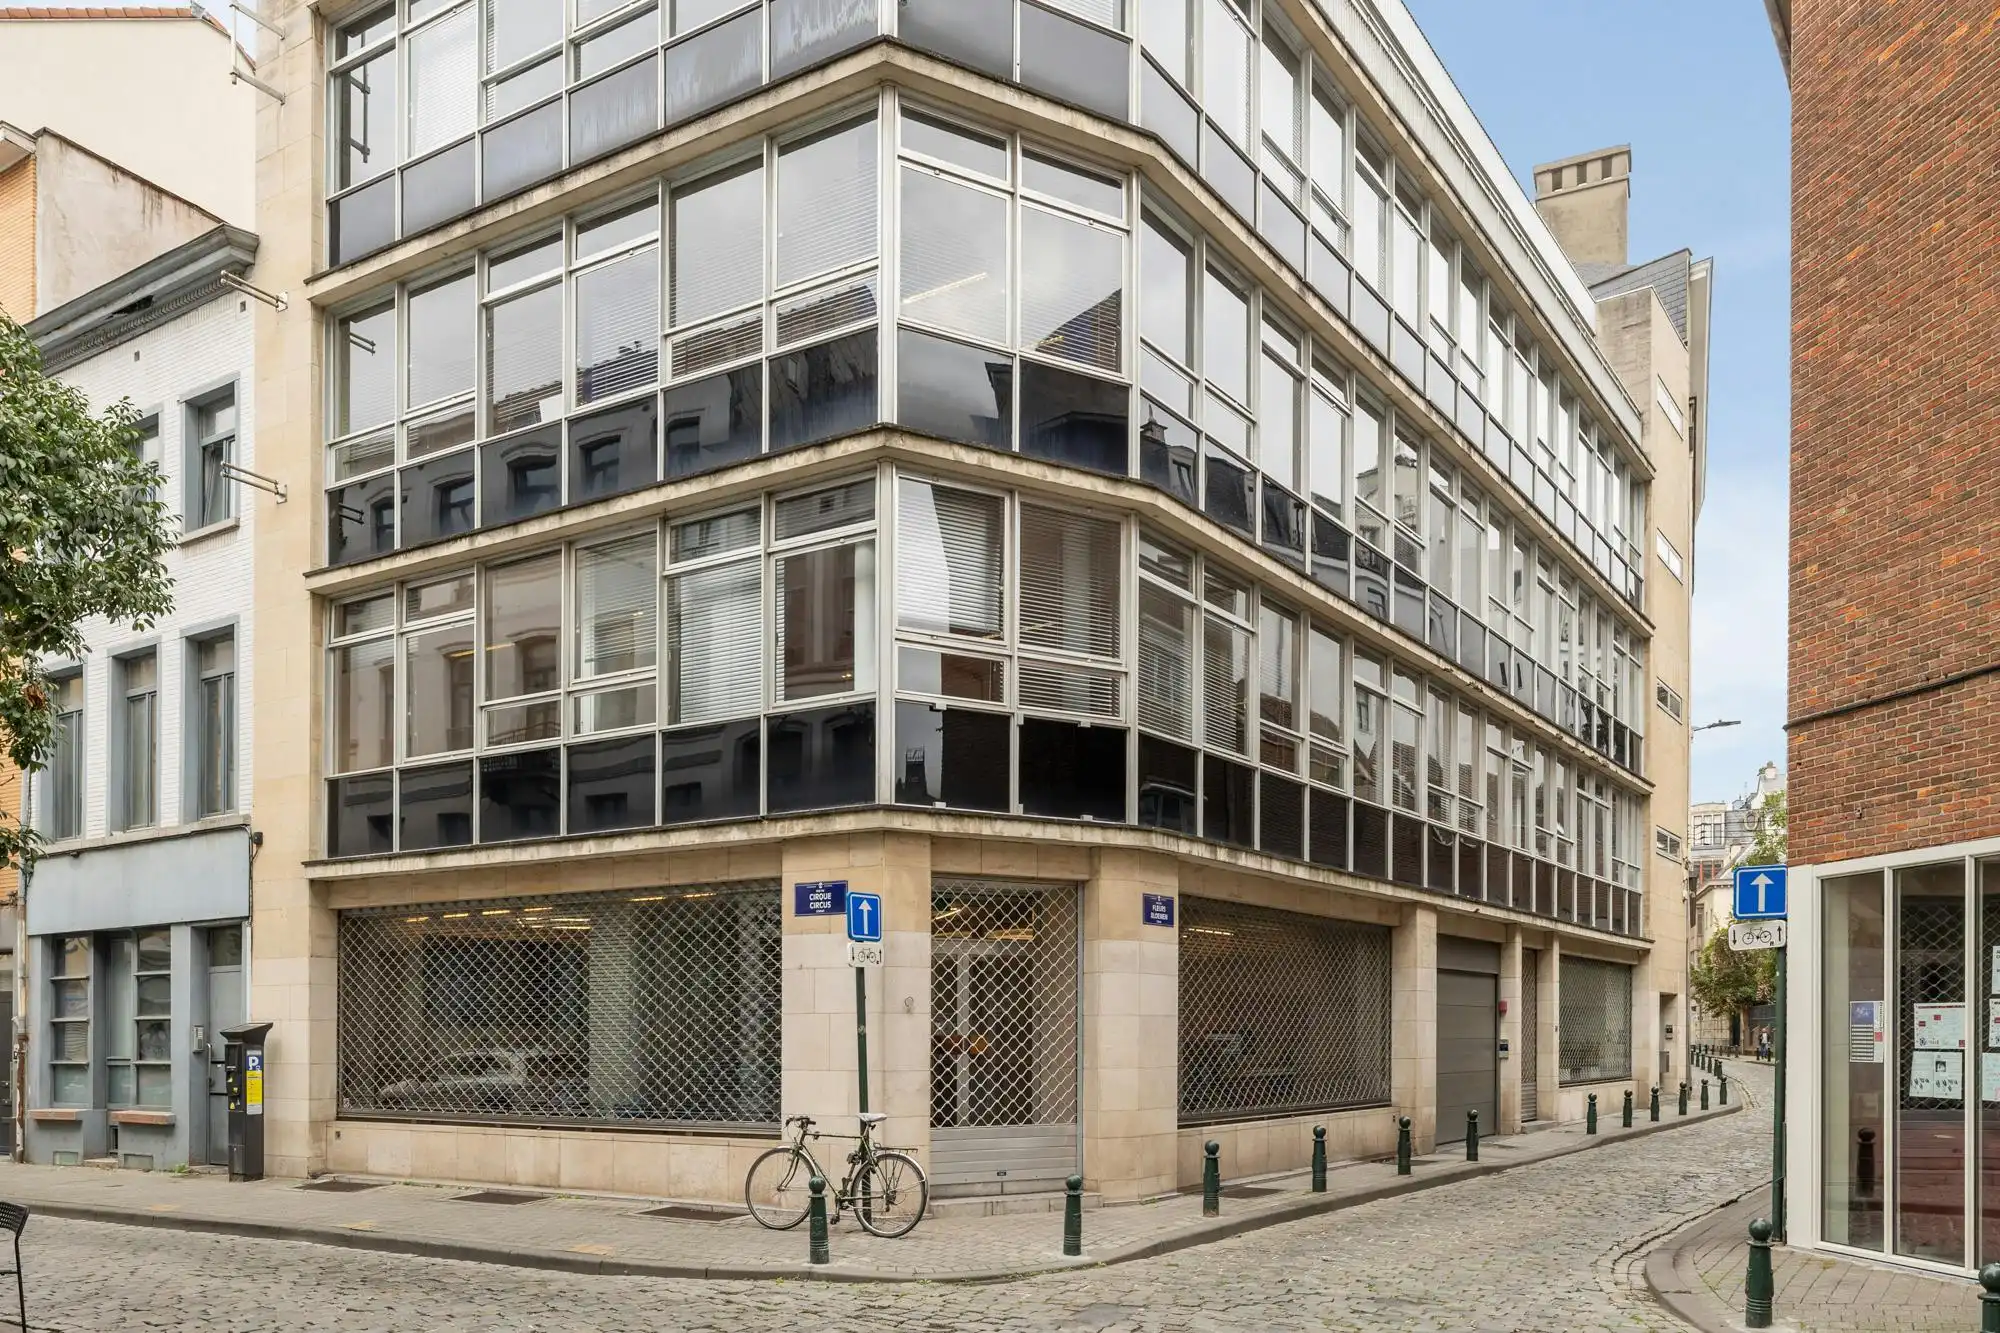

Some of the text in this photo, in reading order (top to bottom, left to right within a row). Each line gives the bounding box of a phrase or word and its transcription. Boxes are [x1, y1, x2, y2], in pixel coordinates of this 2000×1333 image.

[809, 892, 831, 900] CIRQUE
[809, 901, 831, 909] CIRCUS
[248, 1056, 259, 1070] P
